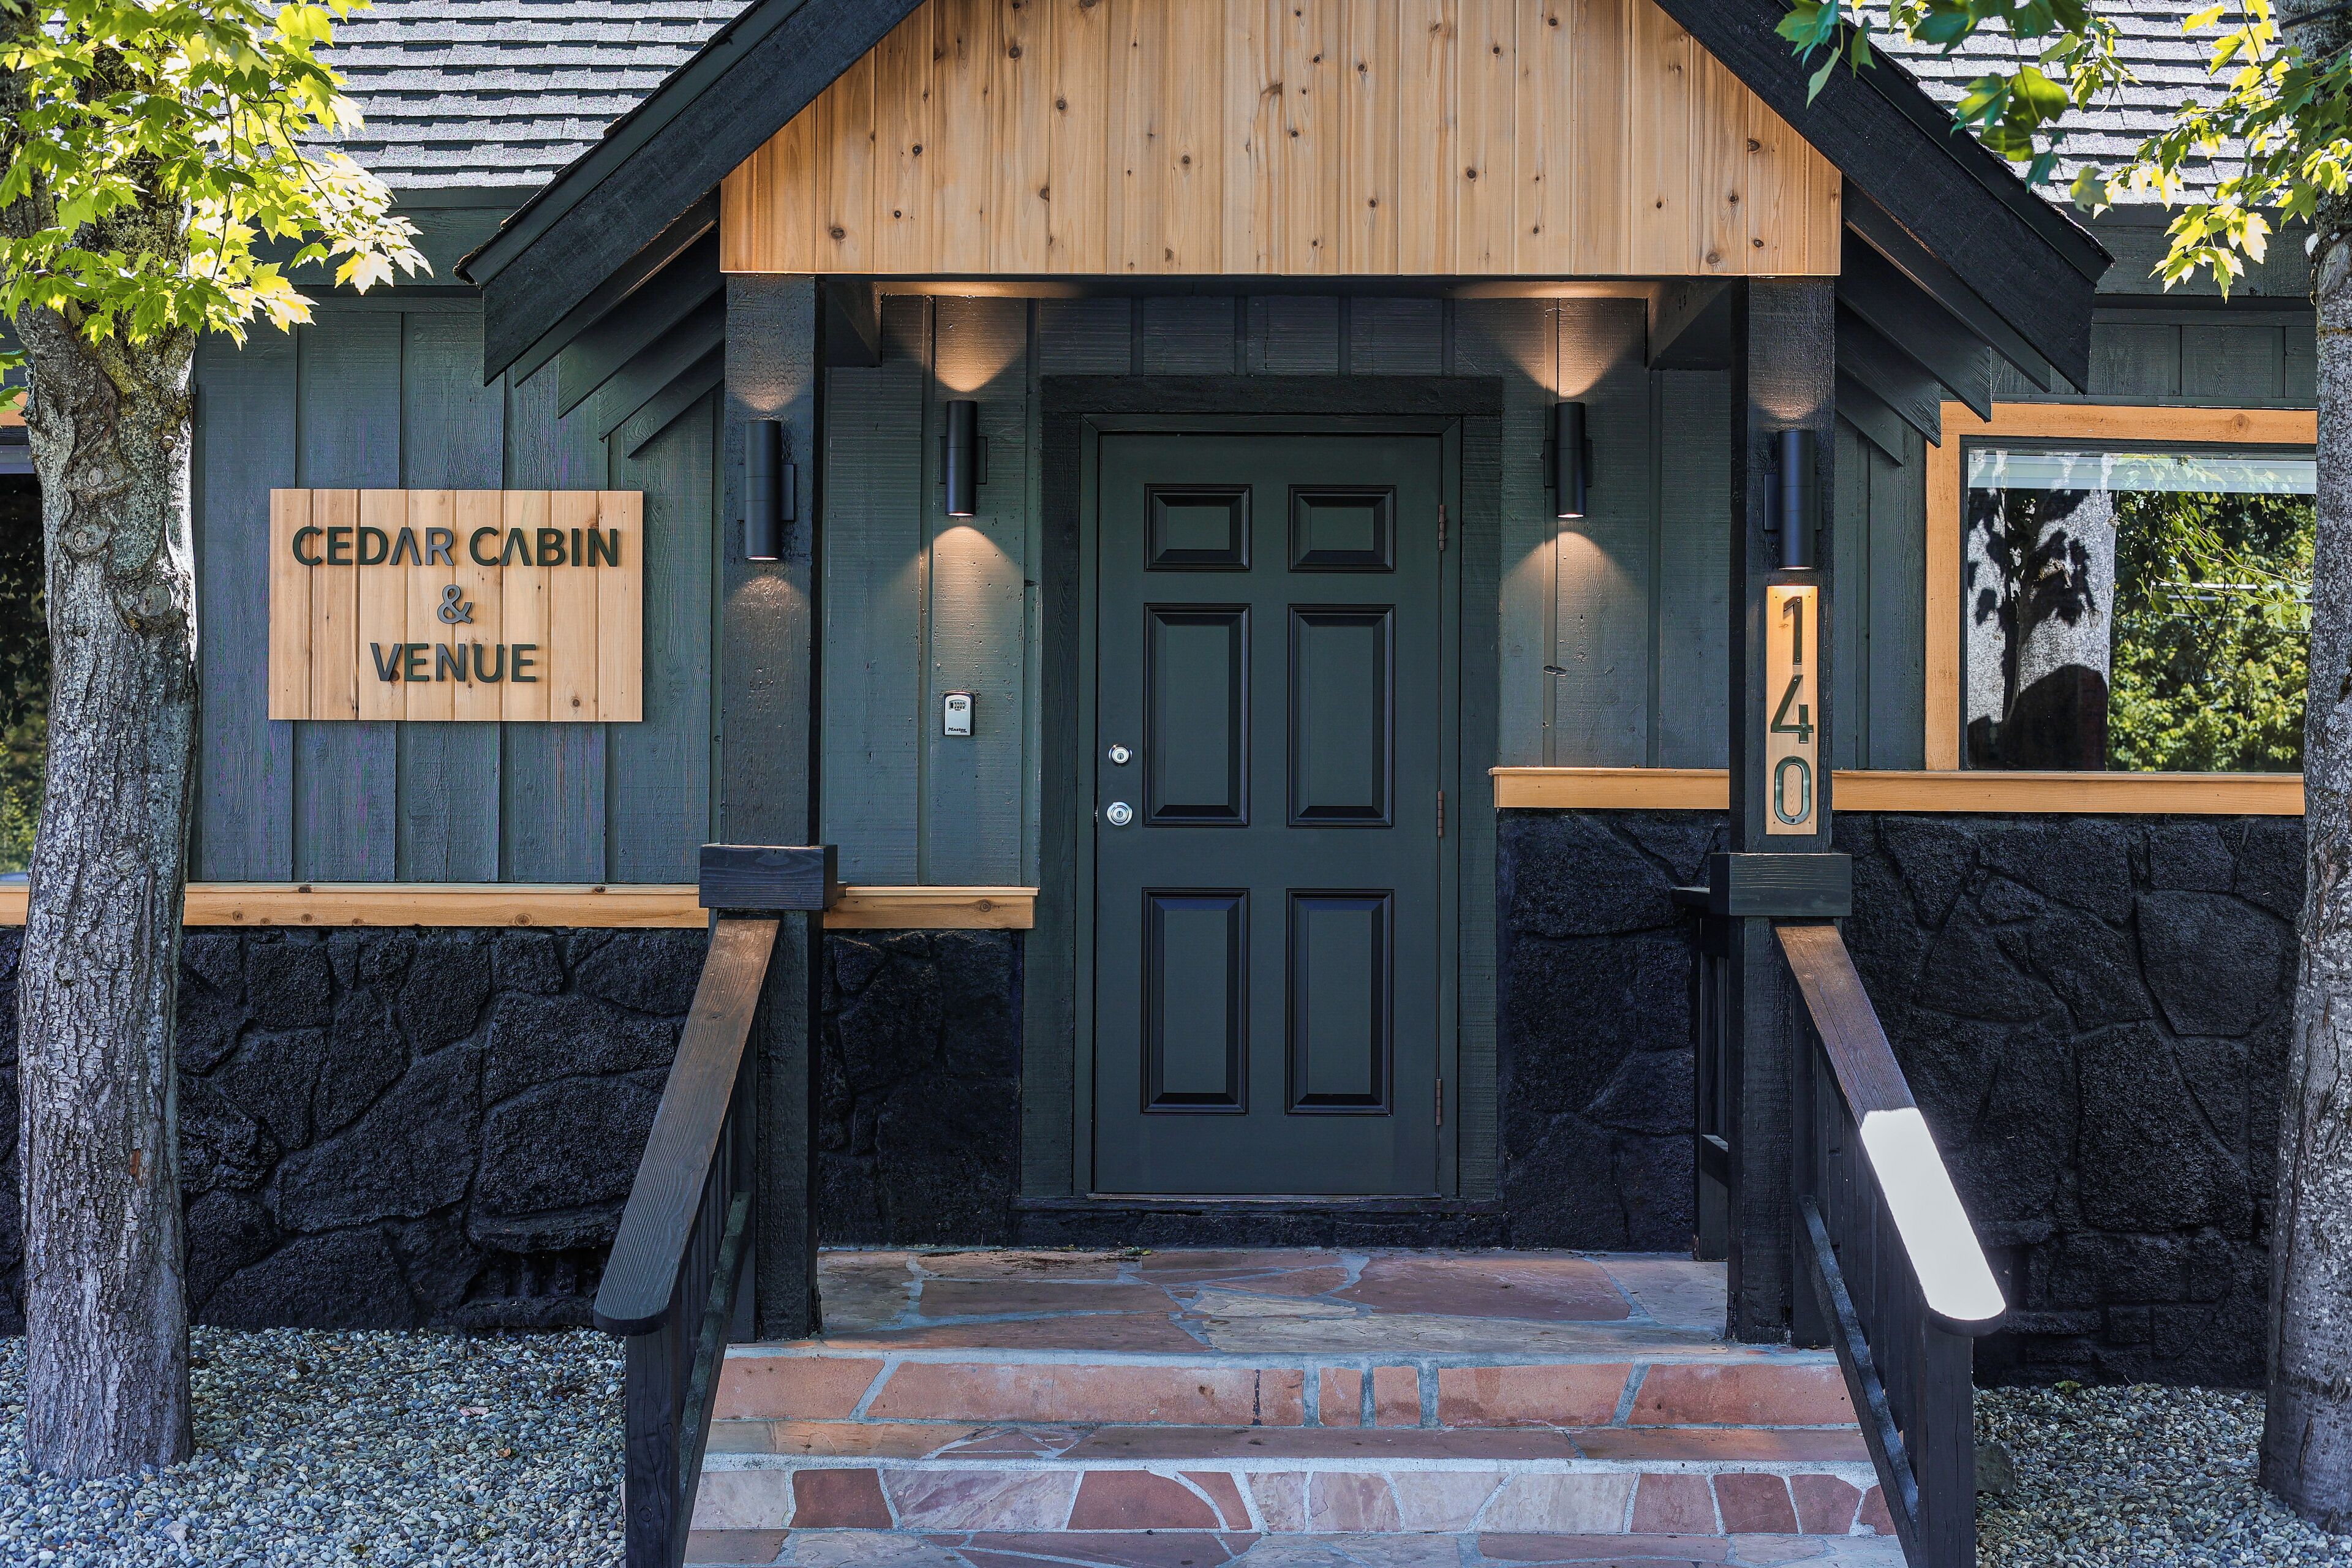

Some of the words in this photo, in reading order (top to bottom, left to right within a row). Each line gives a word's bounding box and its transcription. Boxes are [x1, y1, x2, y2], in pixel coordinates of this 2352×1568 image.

[292, 526, 454, 566] CEDAR
[469, 526, 618, 567] CABIN
[436, 584, 473, 625] &
[370, 643, 537, 684] VENUE
[1770, 596, 1814, 825] 140
